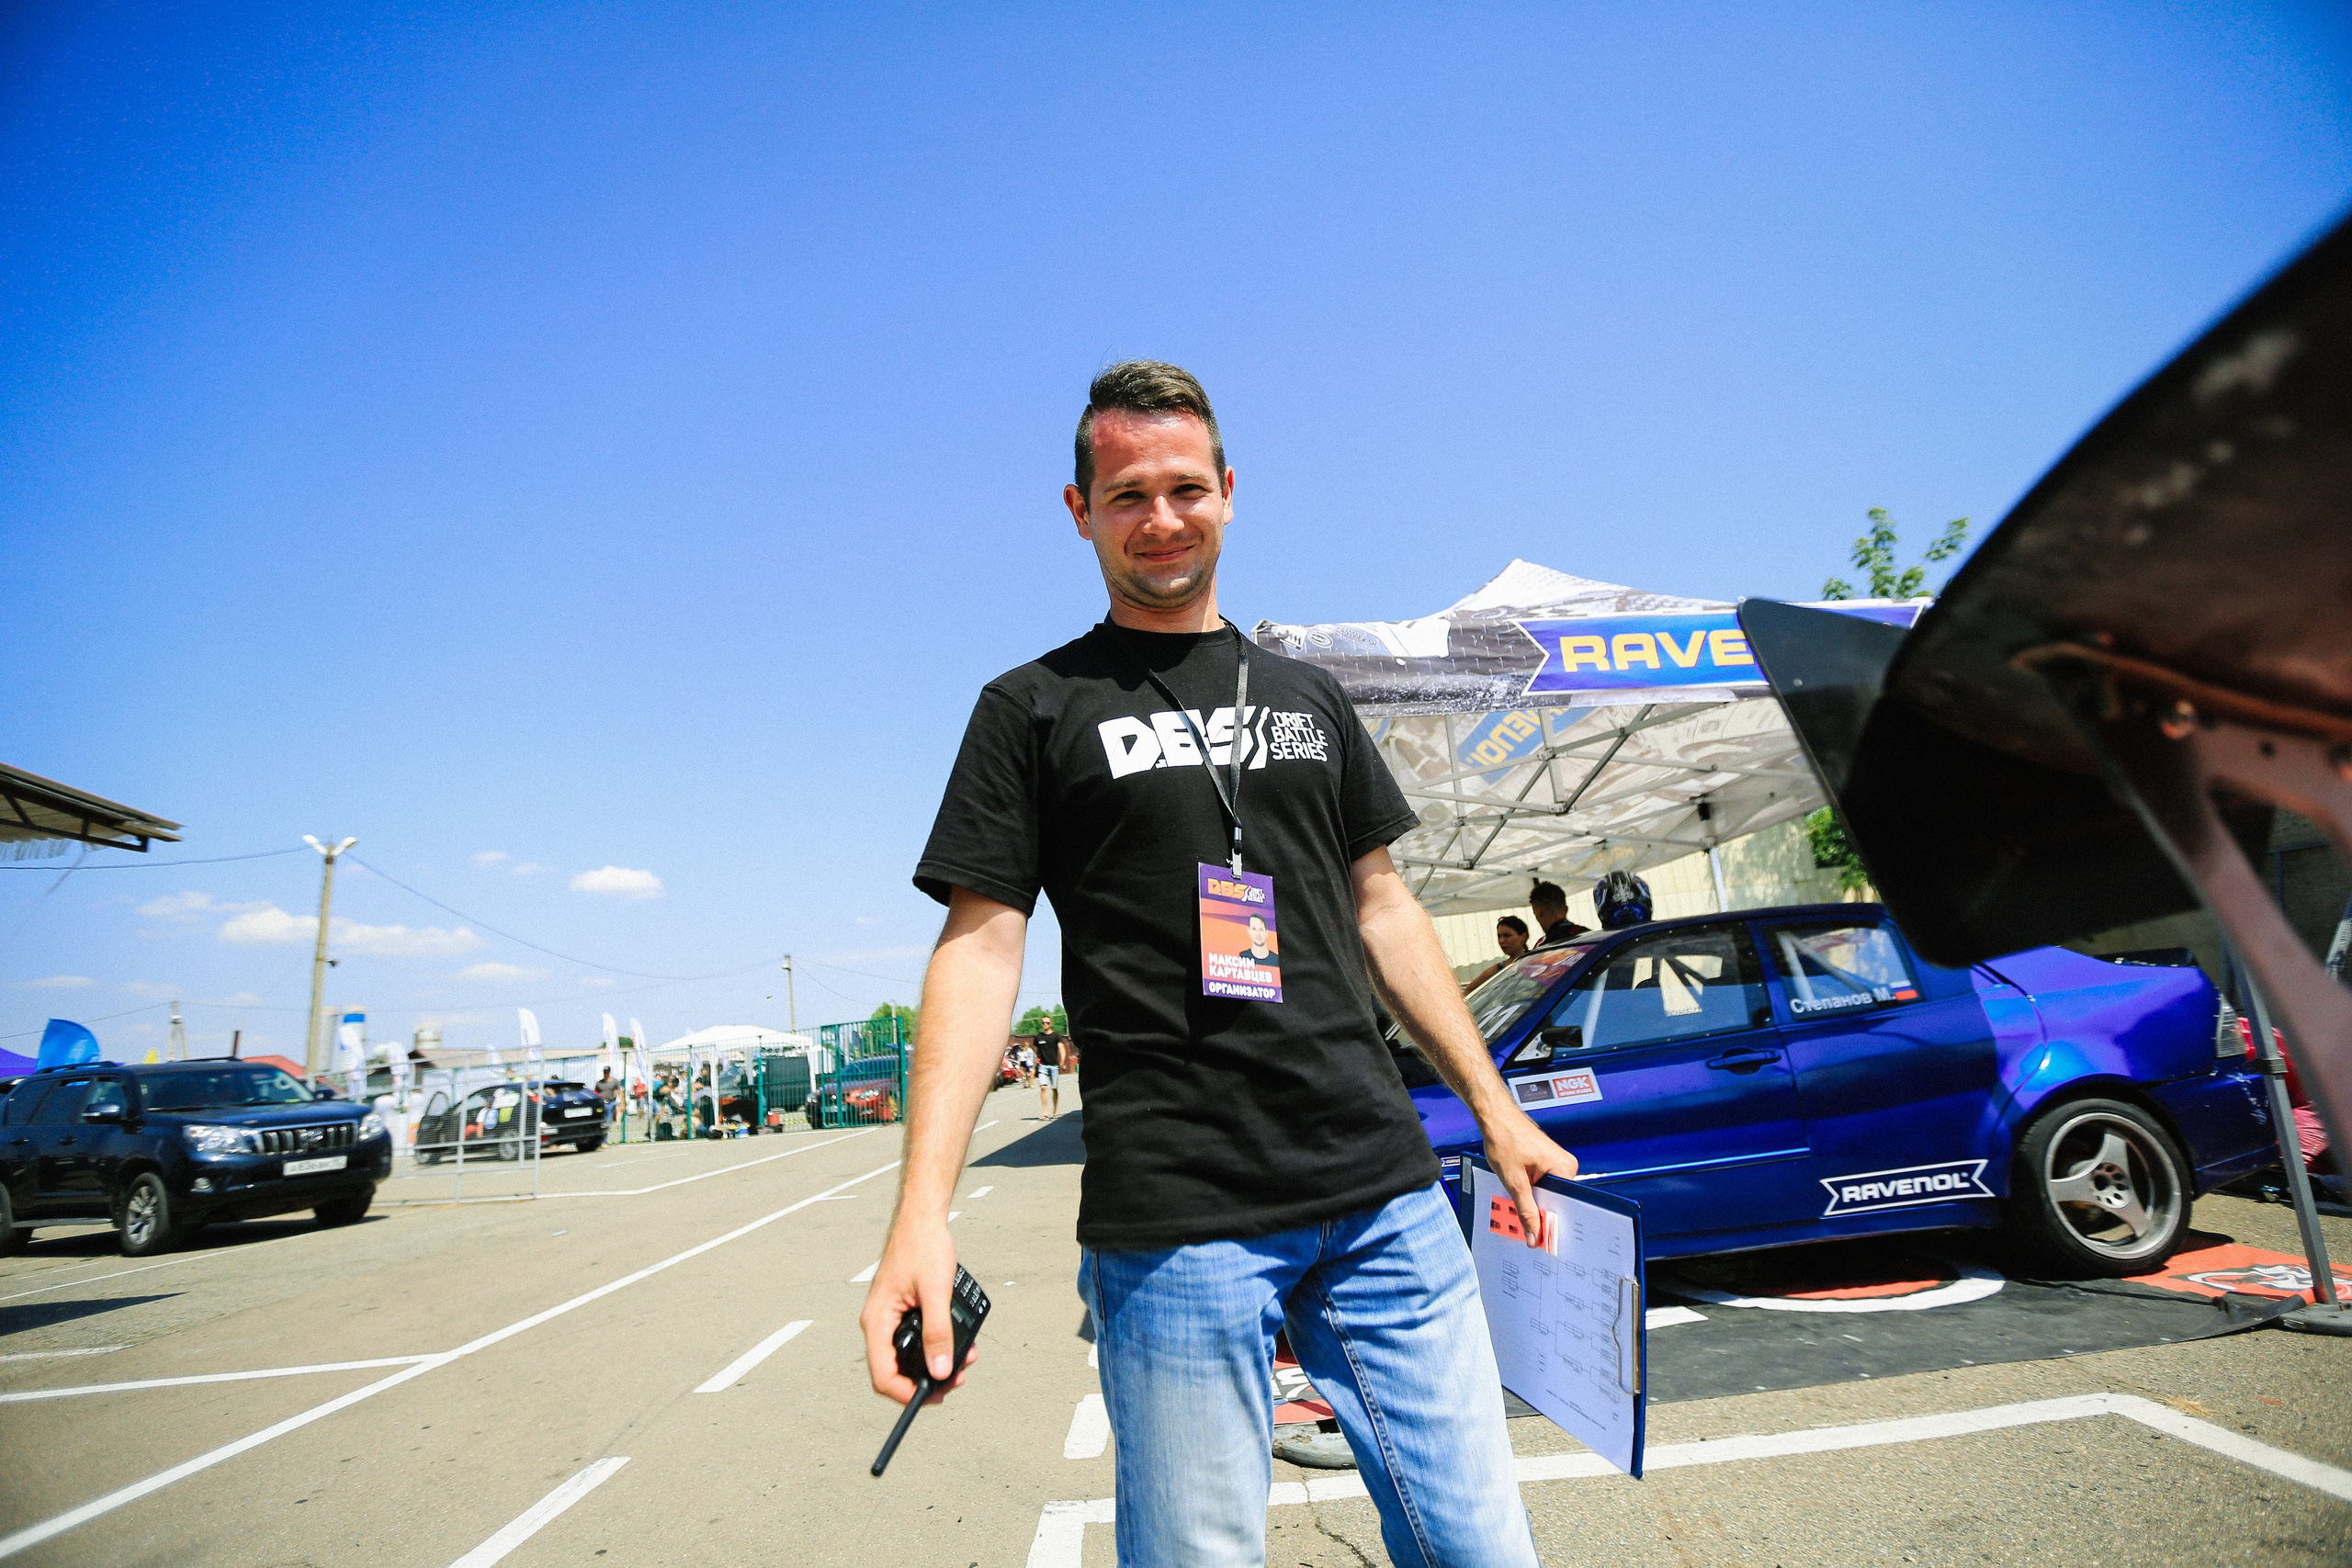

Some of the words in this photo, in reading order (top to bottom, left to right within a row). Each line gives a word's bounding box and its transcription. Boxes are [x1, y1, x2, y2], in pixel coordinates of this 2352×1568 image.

[1559, 628, 1755, 672] RAVE
[1272, 712, 1314, 729] DRIFT
[1271, 726, 1329, 748] BATTLE
[1270, 742, 1329, 762] SERIES
[1208, 952, 1256, 970] МАКСИМ
[1209, 964, 1273, 984] КАРТАВЦЕВ
[1208, 981, 1276, 999] ОРГАНИЗАТОР
[1790, 992, 1873, 1014] Степанов
[1555, 1076, 1590, 1092] NGK
[1841, 1173, 1971, 1203] RAVENOL
